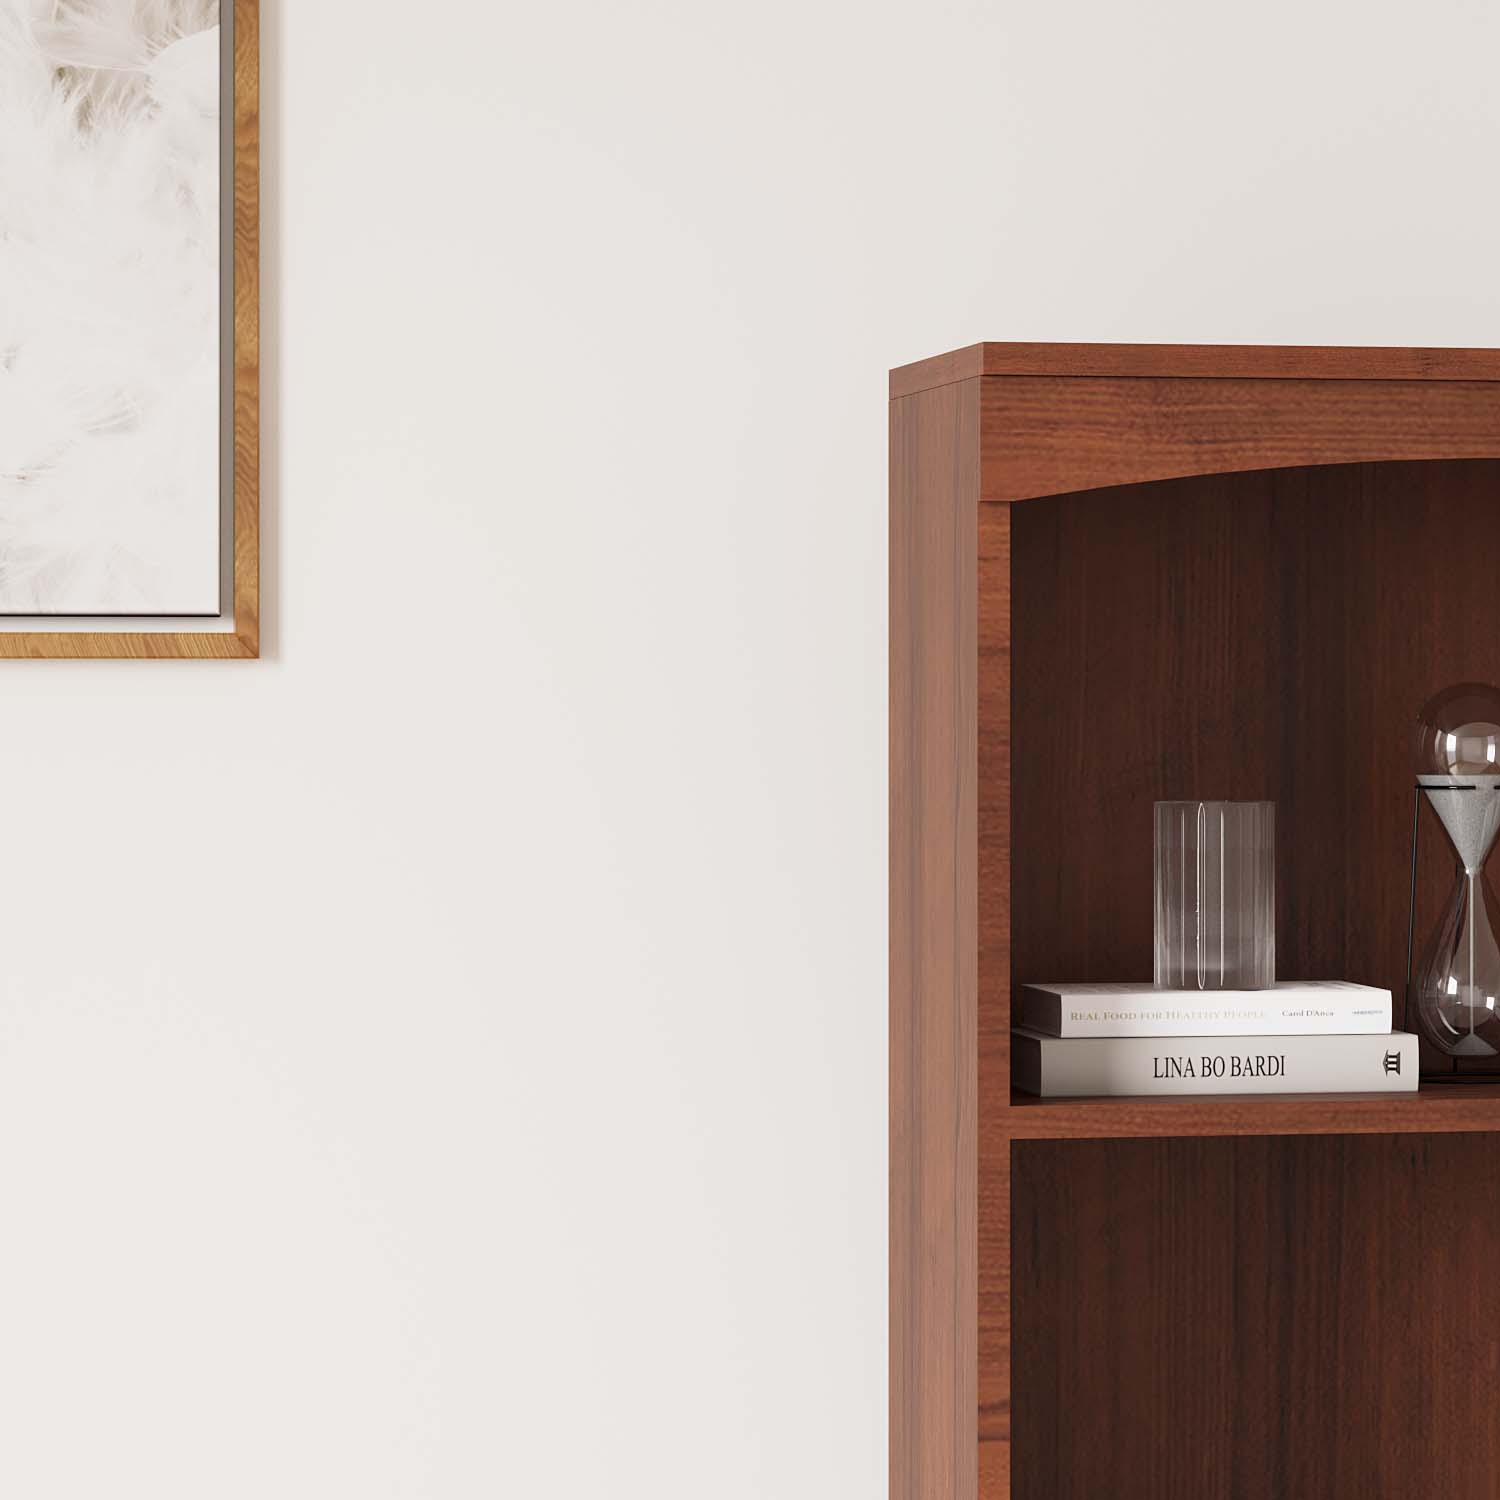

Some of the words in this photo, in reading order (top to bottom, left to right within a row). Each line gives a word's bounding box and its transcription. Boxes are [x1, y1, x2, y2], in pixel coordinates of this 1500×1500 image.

[1070, 1011, 1099, 1021] REAL
[1103, 1011, 1137, 1021] FOOD
[1153, 1056, 1195, 1079] LINA
[1200, 1056, 1225, 1078] BO
[1230, 1055, 1285, 1077] BARDI
